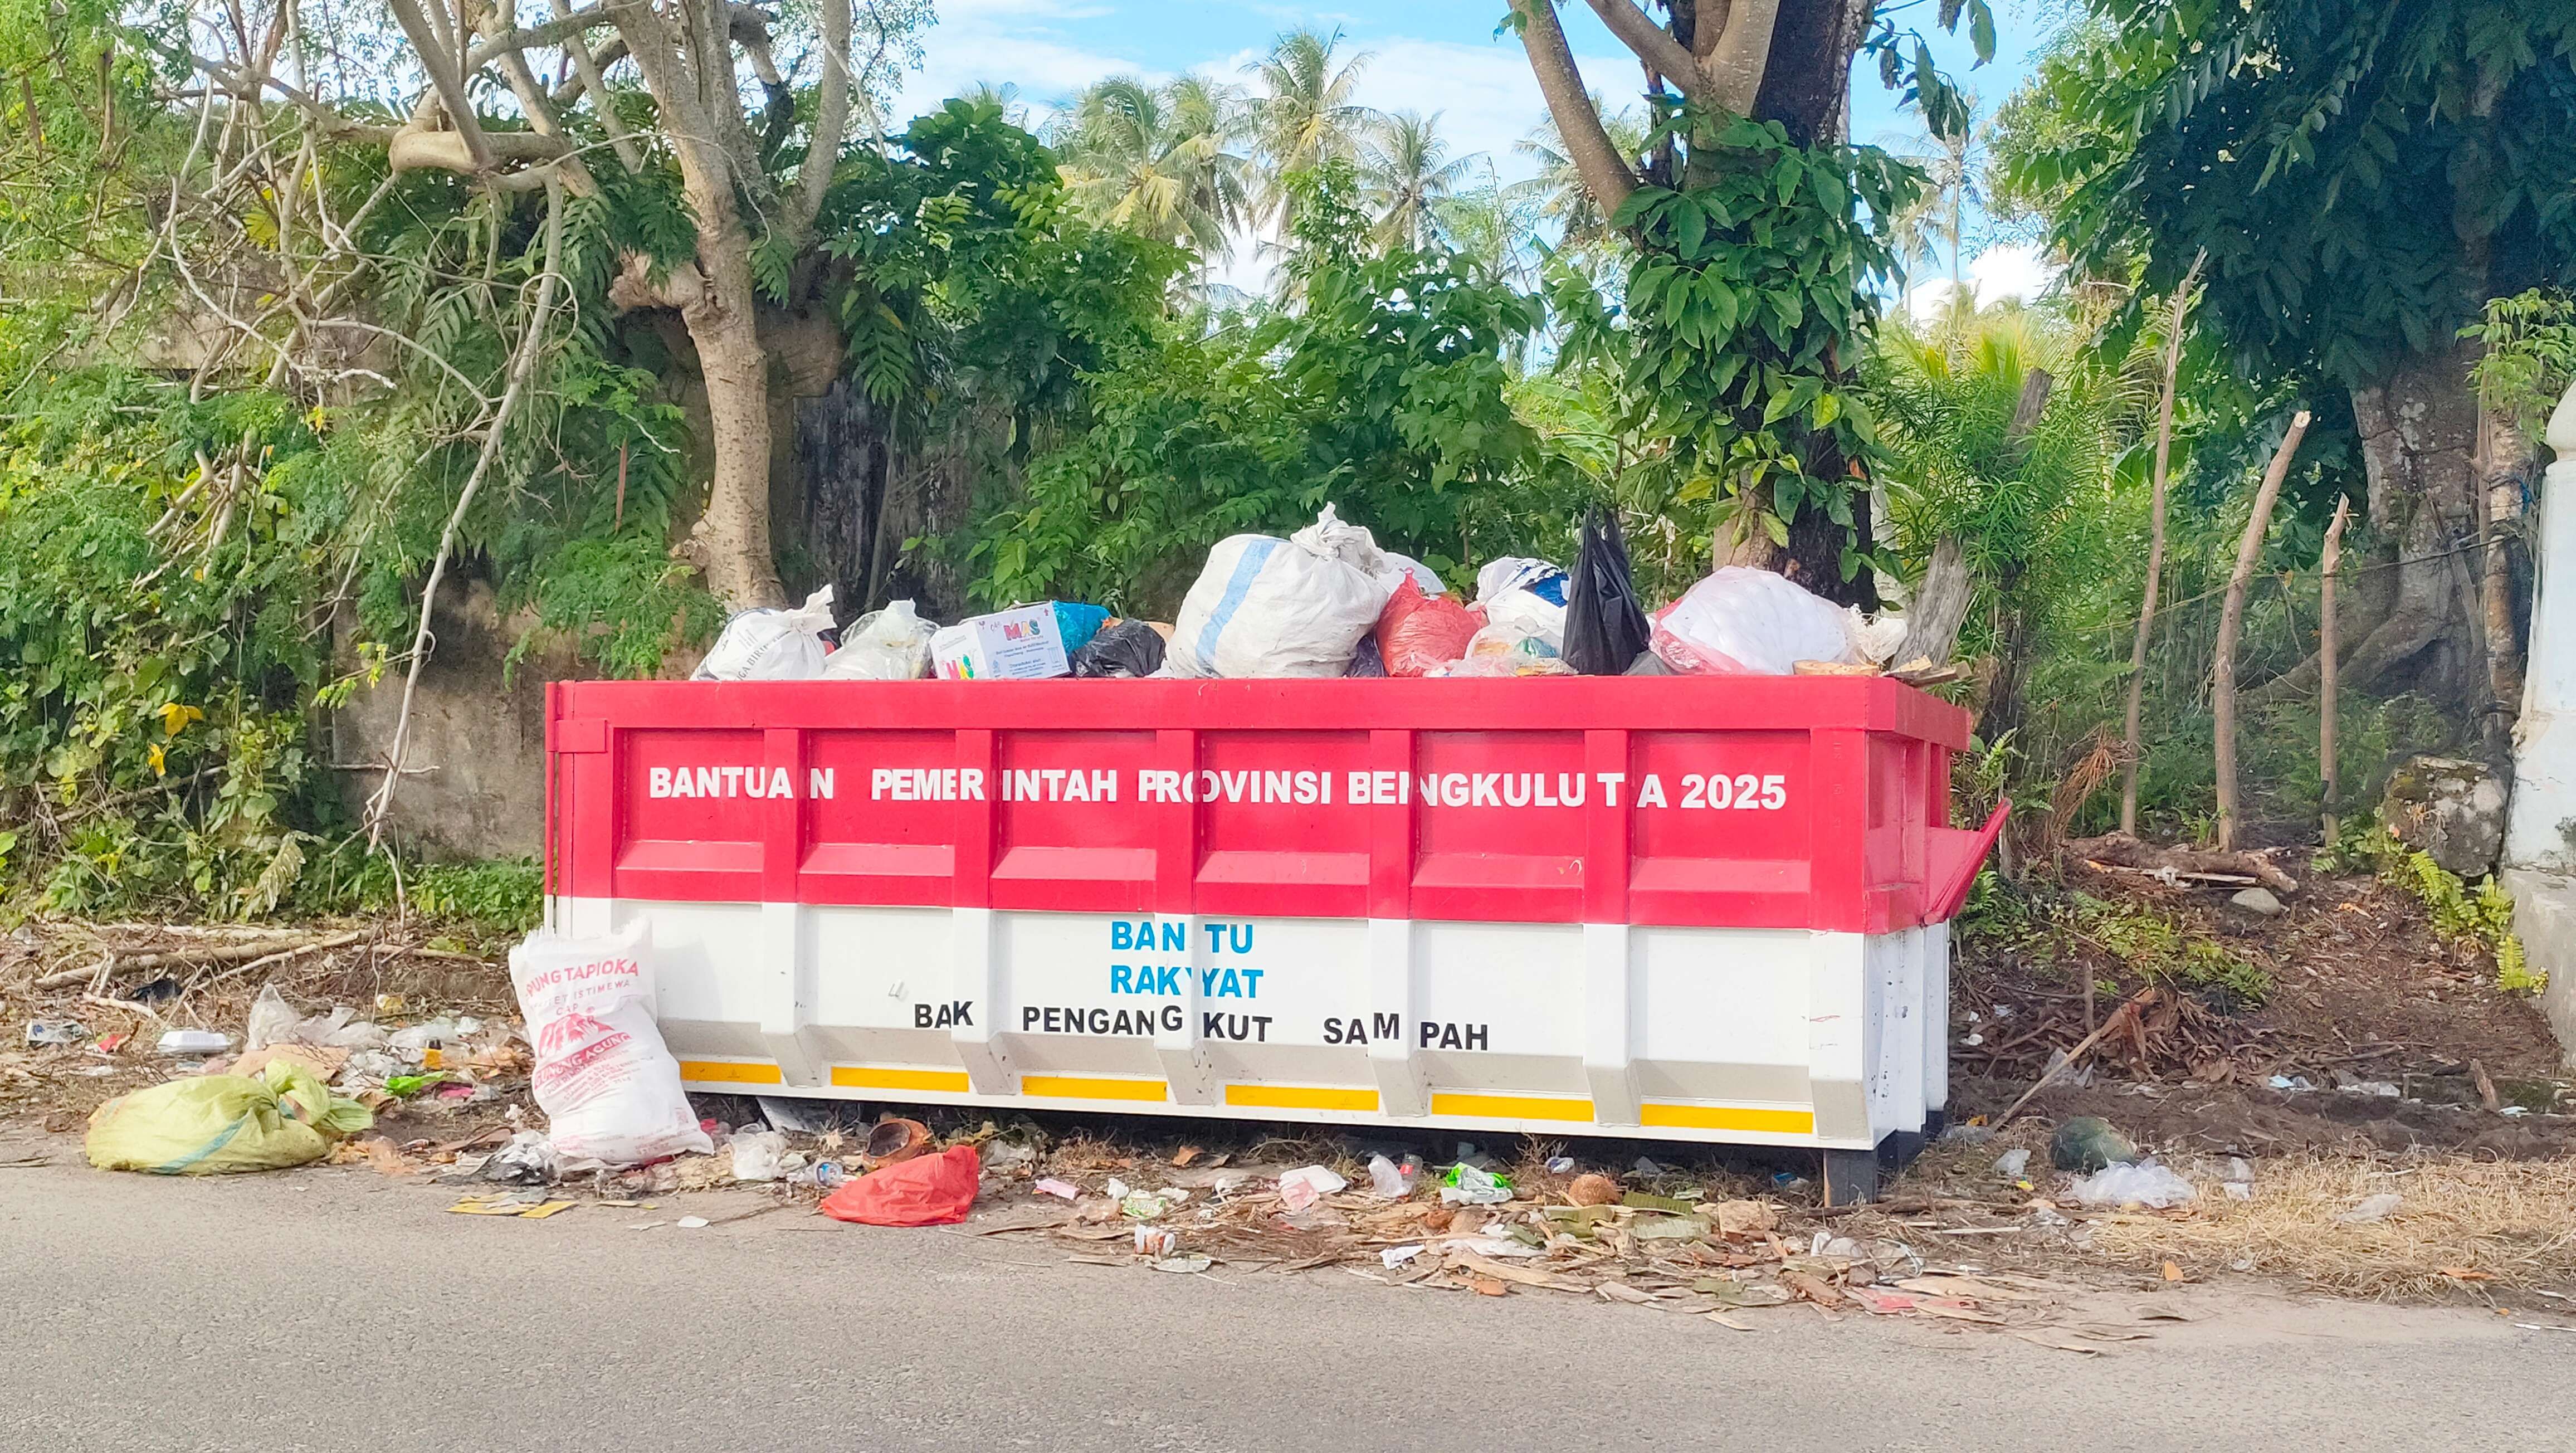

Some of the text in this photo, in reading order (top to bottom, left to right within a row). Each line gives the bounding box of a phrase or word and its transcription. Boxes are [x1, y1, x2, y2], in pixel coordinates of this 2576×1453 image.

[1003, 619, 1040, 640] MAS
[650, 767, 834, 799] BANTUAN
[871, 768, 1117, 802] PEMERINTAH
[1138, 769, 1331, 804] PROVINSI
[1680, 774, 1787, 810] 2025
[1111, 921, 1253, 954] BANTU
[526, 958, 639, 998] PUNG TAPIOKA
[574, 979, 631, 999] ISTIMEWA
[1111, 964, 1264, 998] RAKYAT
[556, 1003, 579, 1016] CAP
[914, 1001, 974, 1028] BAK
